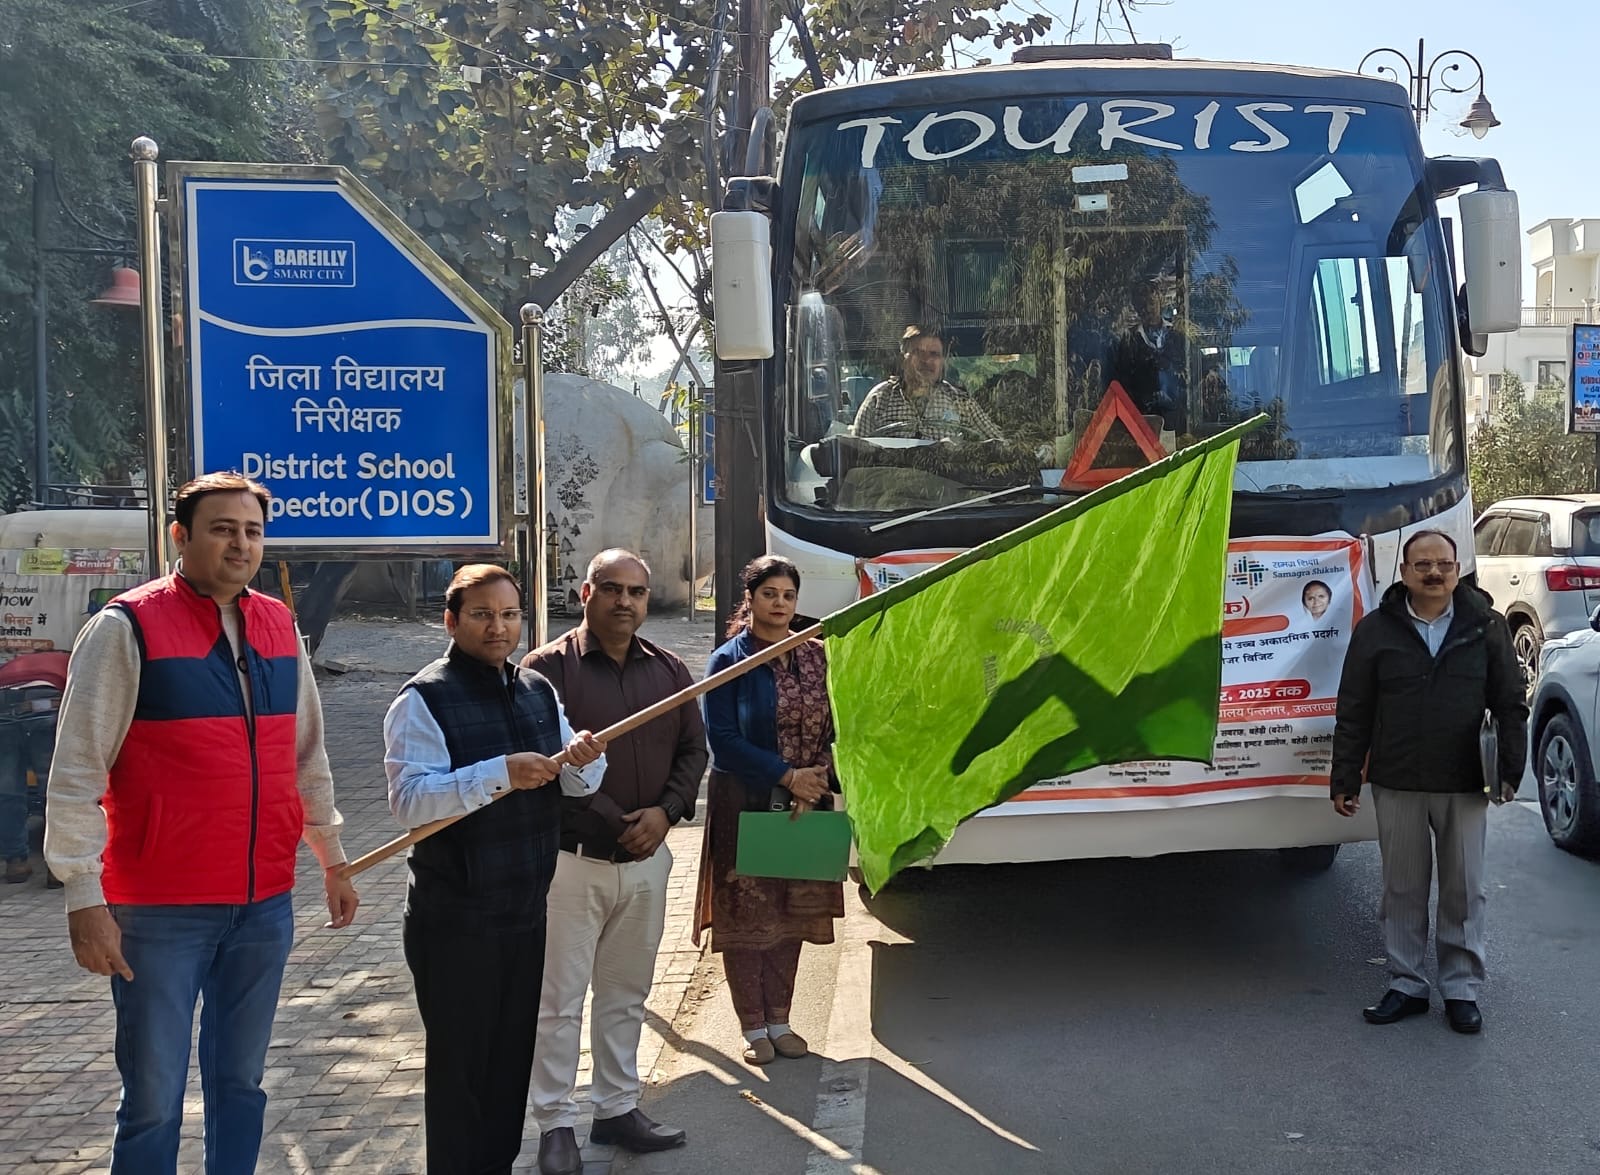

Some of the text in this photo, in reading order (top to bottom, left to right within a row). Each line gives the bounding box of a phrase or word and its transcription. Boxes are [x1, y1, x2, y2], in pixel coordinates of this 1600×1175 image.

[837, 99, 1367, 169] TOURIST
[274, 248, 348, 267] BAREILLY
[273, 268, 346, 280] SMART CITY
[245, 354, 446, 391] जिला विद्यालय
[291, 397, 403, 433] निरीक्षक
[242, 451, 456, 480] District School
[1272, 565, 1345, 579] Samagra Shiksha
[37, 612, 47, 626] में
[1239, 687, 1271, 699] 2025
[1275, 685, 1304, 697] तक
